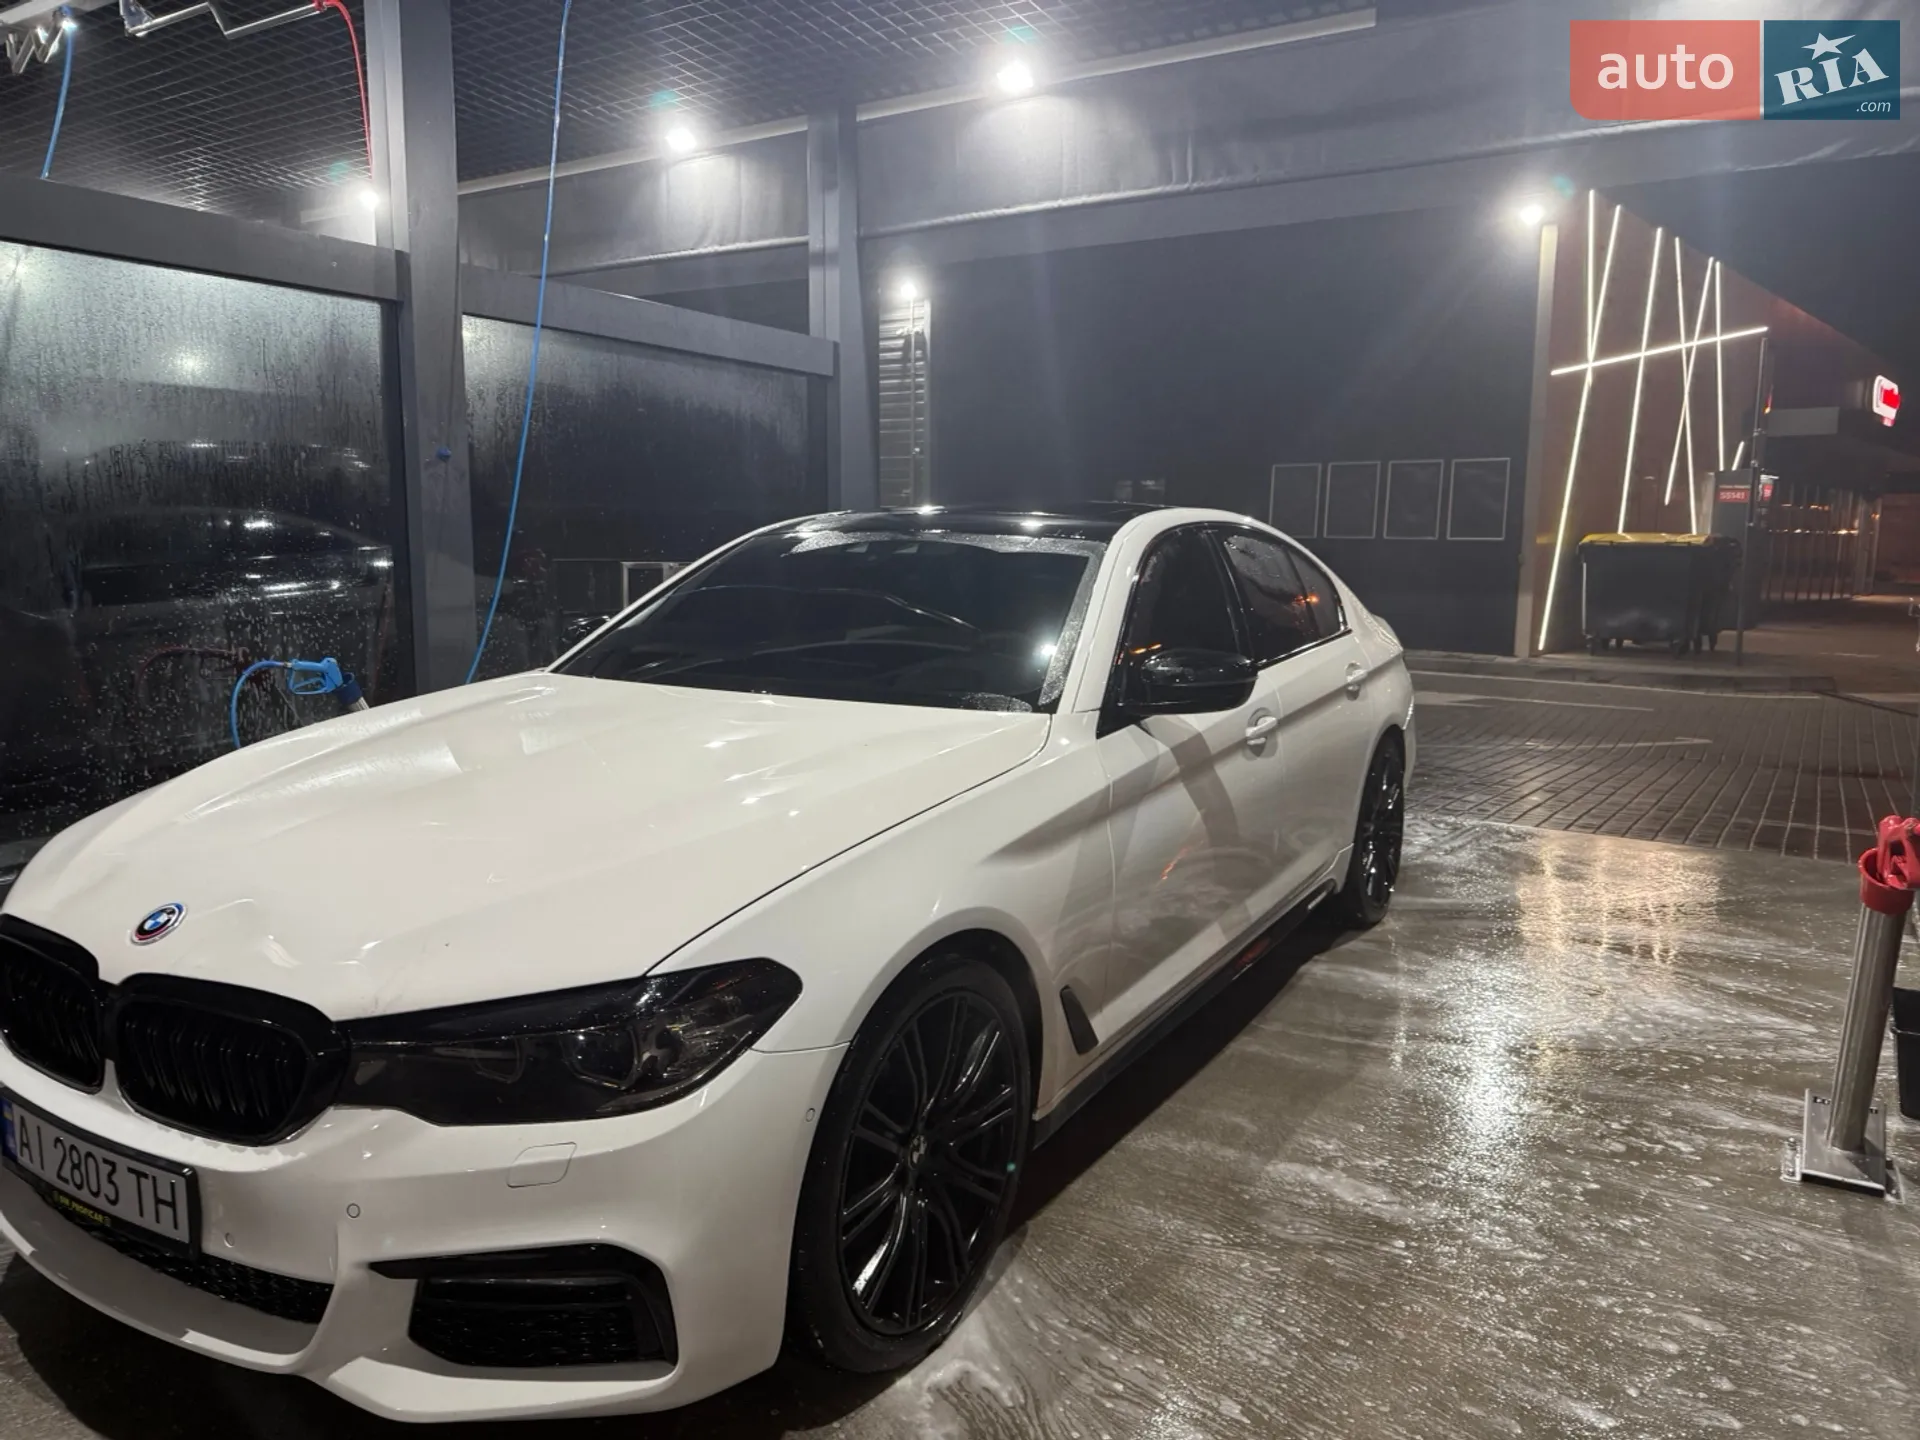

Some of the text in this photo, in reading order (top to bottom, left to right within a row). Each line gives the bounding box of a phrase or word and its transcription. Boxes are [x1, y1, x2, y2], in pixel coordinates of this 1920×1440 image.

[19, 1115, 45, 1171] AI
[54, 1136, 120, 1207] 2803
[127, 1166, 179, 1231] TH
